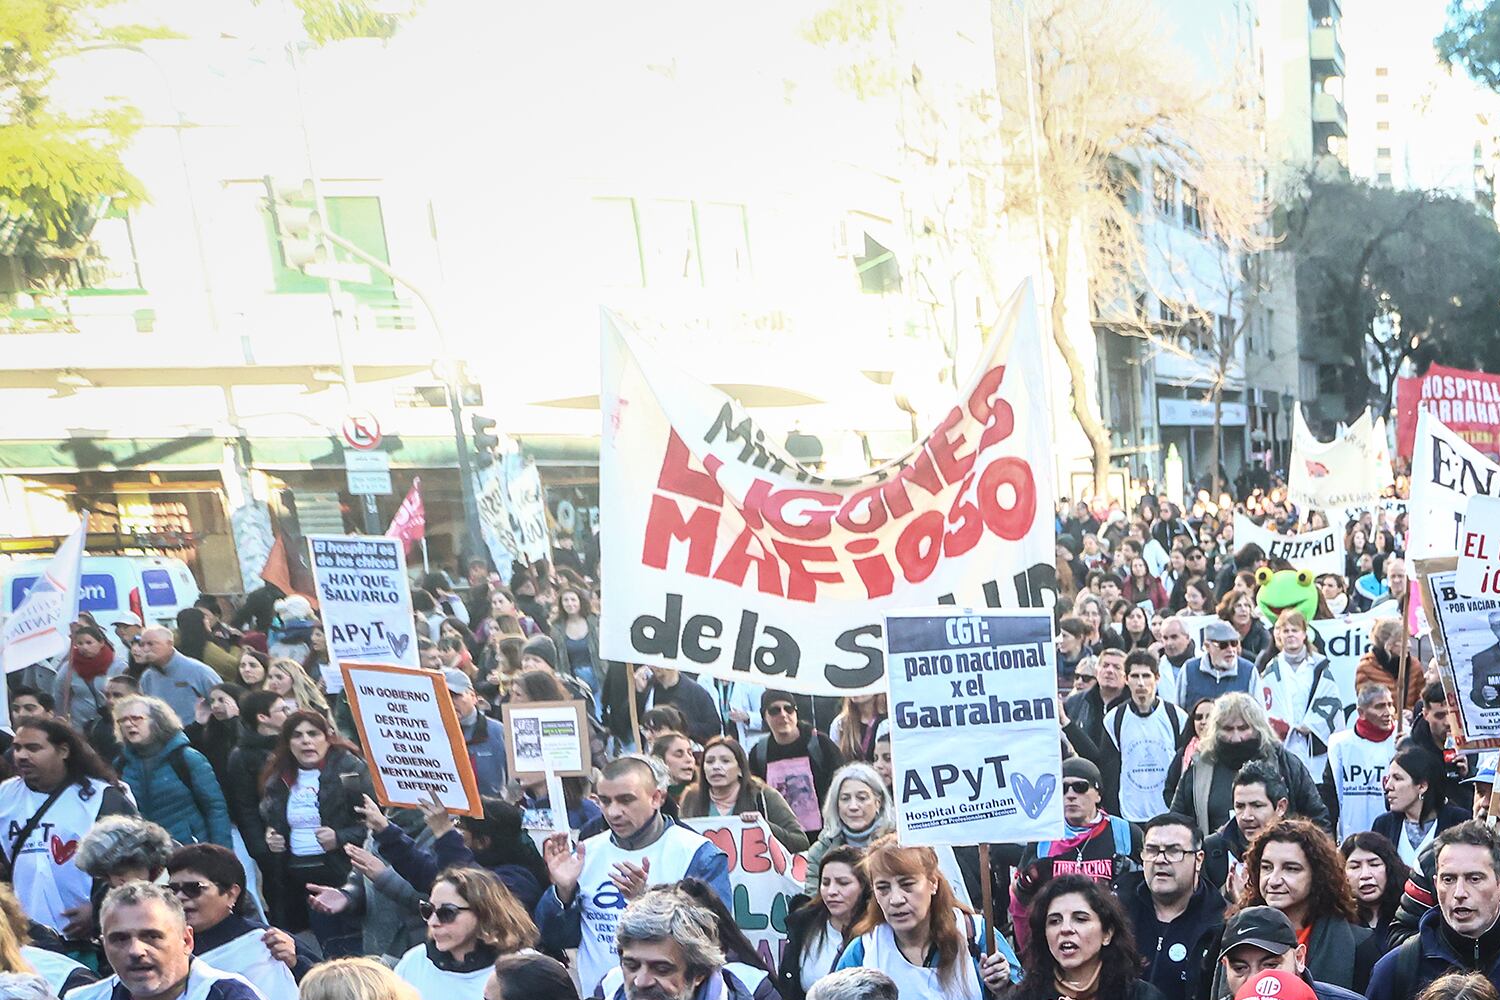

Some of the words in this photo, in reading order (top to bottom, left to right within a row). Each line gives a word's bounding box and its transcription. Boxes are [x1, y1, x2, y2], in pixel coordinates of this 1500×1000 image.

[314, 541, 326, 553] El
[326, 541, 376, 558] hospital
[377, 545, 396, 557] es
[1463, 531, 1489, 560] EL
[317, 554, 331, 567] de
[333, 555, 353, 567] los
[354, 556, 397, 569] chicos
[328, 573, 357, 587] HAY
[359, 574, 391, 589] QUE
[325, 588, 399, 604] SALVARLO
[1466, 599, 1497, 612] VACIAR
[331, 621, 386, 645] APyT
[630, 593, 723, 664] de
[732, 610, 801, 679] la
[945, 616, 991, 646] CGT:
[903, 653, 954, 682] paro
[956, 642, 1047, 675] nacional
[360, 686, 376, 697] UN
[377, 687, 431, 702] GOBIERNO
[950, 680, 962, 698] x
[965, 673, 986, 697] el
[387, 702, 409, 714] QUE
[895, 695, 1055, 730] Garrahan
[374, 714, 429, 729] DESTRUYE
[380, 728, 394, 738] LA
[395, 729, 431, 742] SALUD
[393, 743, 407, 752] ES
[409, 744, 425, 754] UN
[386, 755, 441, 769] GOBIERNO
[380, 766, 457, 783] MENTALMENTE
[901, 754, 1011, 804] APyT
[904, 804, 956, 822] Hospital
[958, 796, 1015, 813] Garrahan
[8, 818, 56, 843] AT
[1052, 858, 1112, 878] LIBERACIÓN
